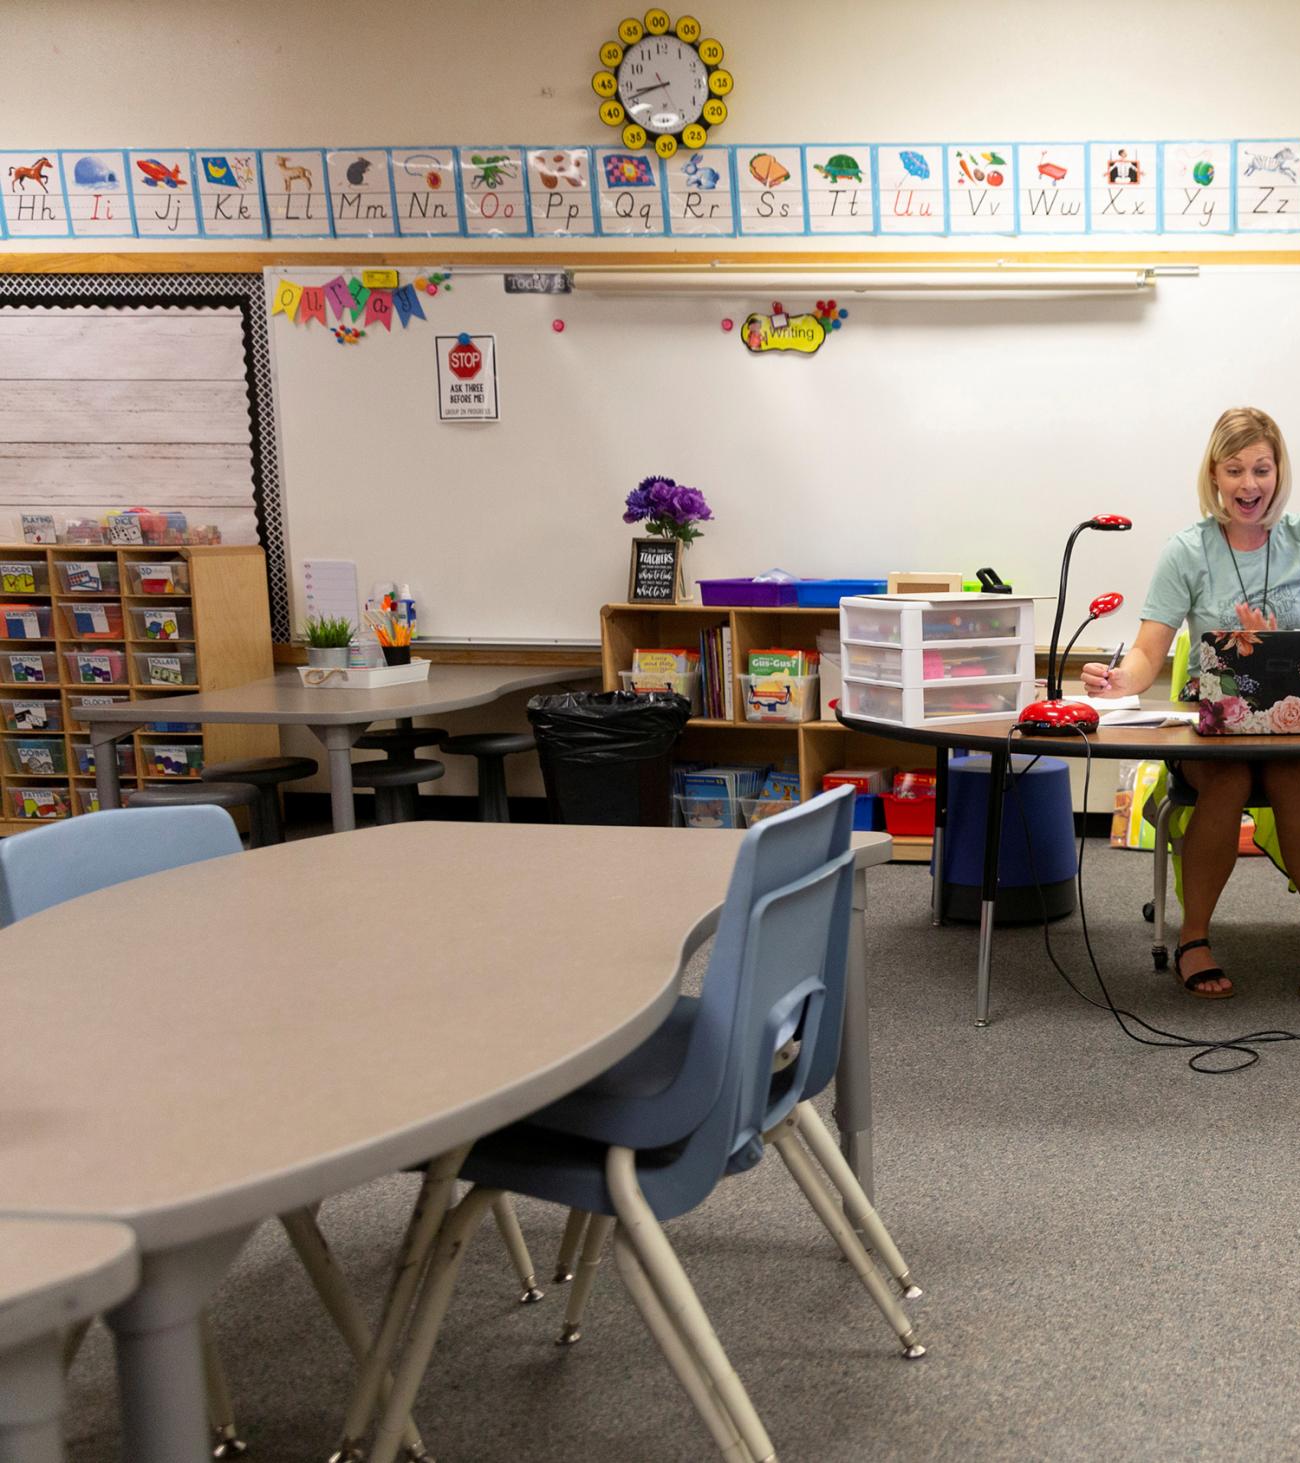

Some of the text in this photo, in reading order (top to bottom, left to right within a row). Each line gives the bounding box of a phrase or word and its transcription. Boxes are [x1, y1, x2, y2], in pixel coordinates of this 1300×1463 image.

[631, 64, 643, 75] 10
[769, 325, 814, 342] Writing
[451, 352, 480, 368] STOP
[450, 383, 484, 393] ASK THREE
[450, 394, 472, 404] BEFORE
[115, 517, 133, 525] DICE
[640, 552, 674, 564] TEACHERS
[752, 659, 796, 668] Gus-Gus?
